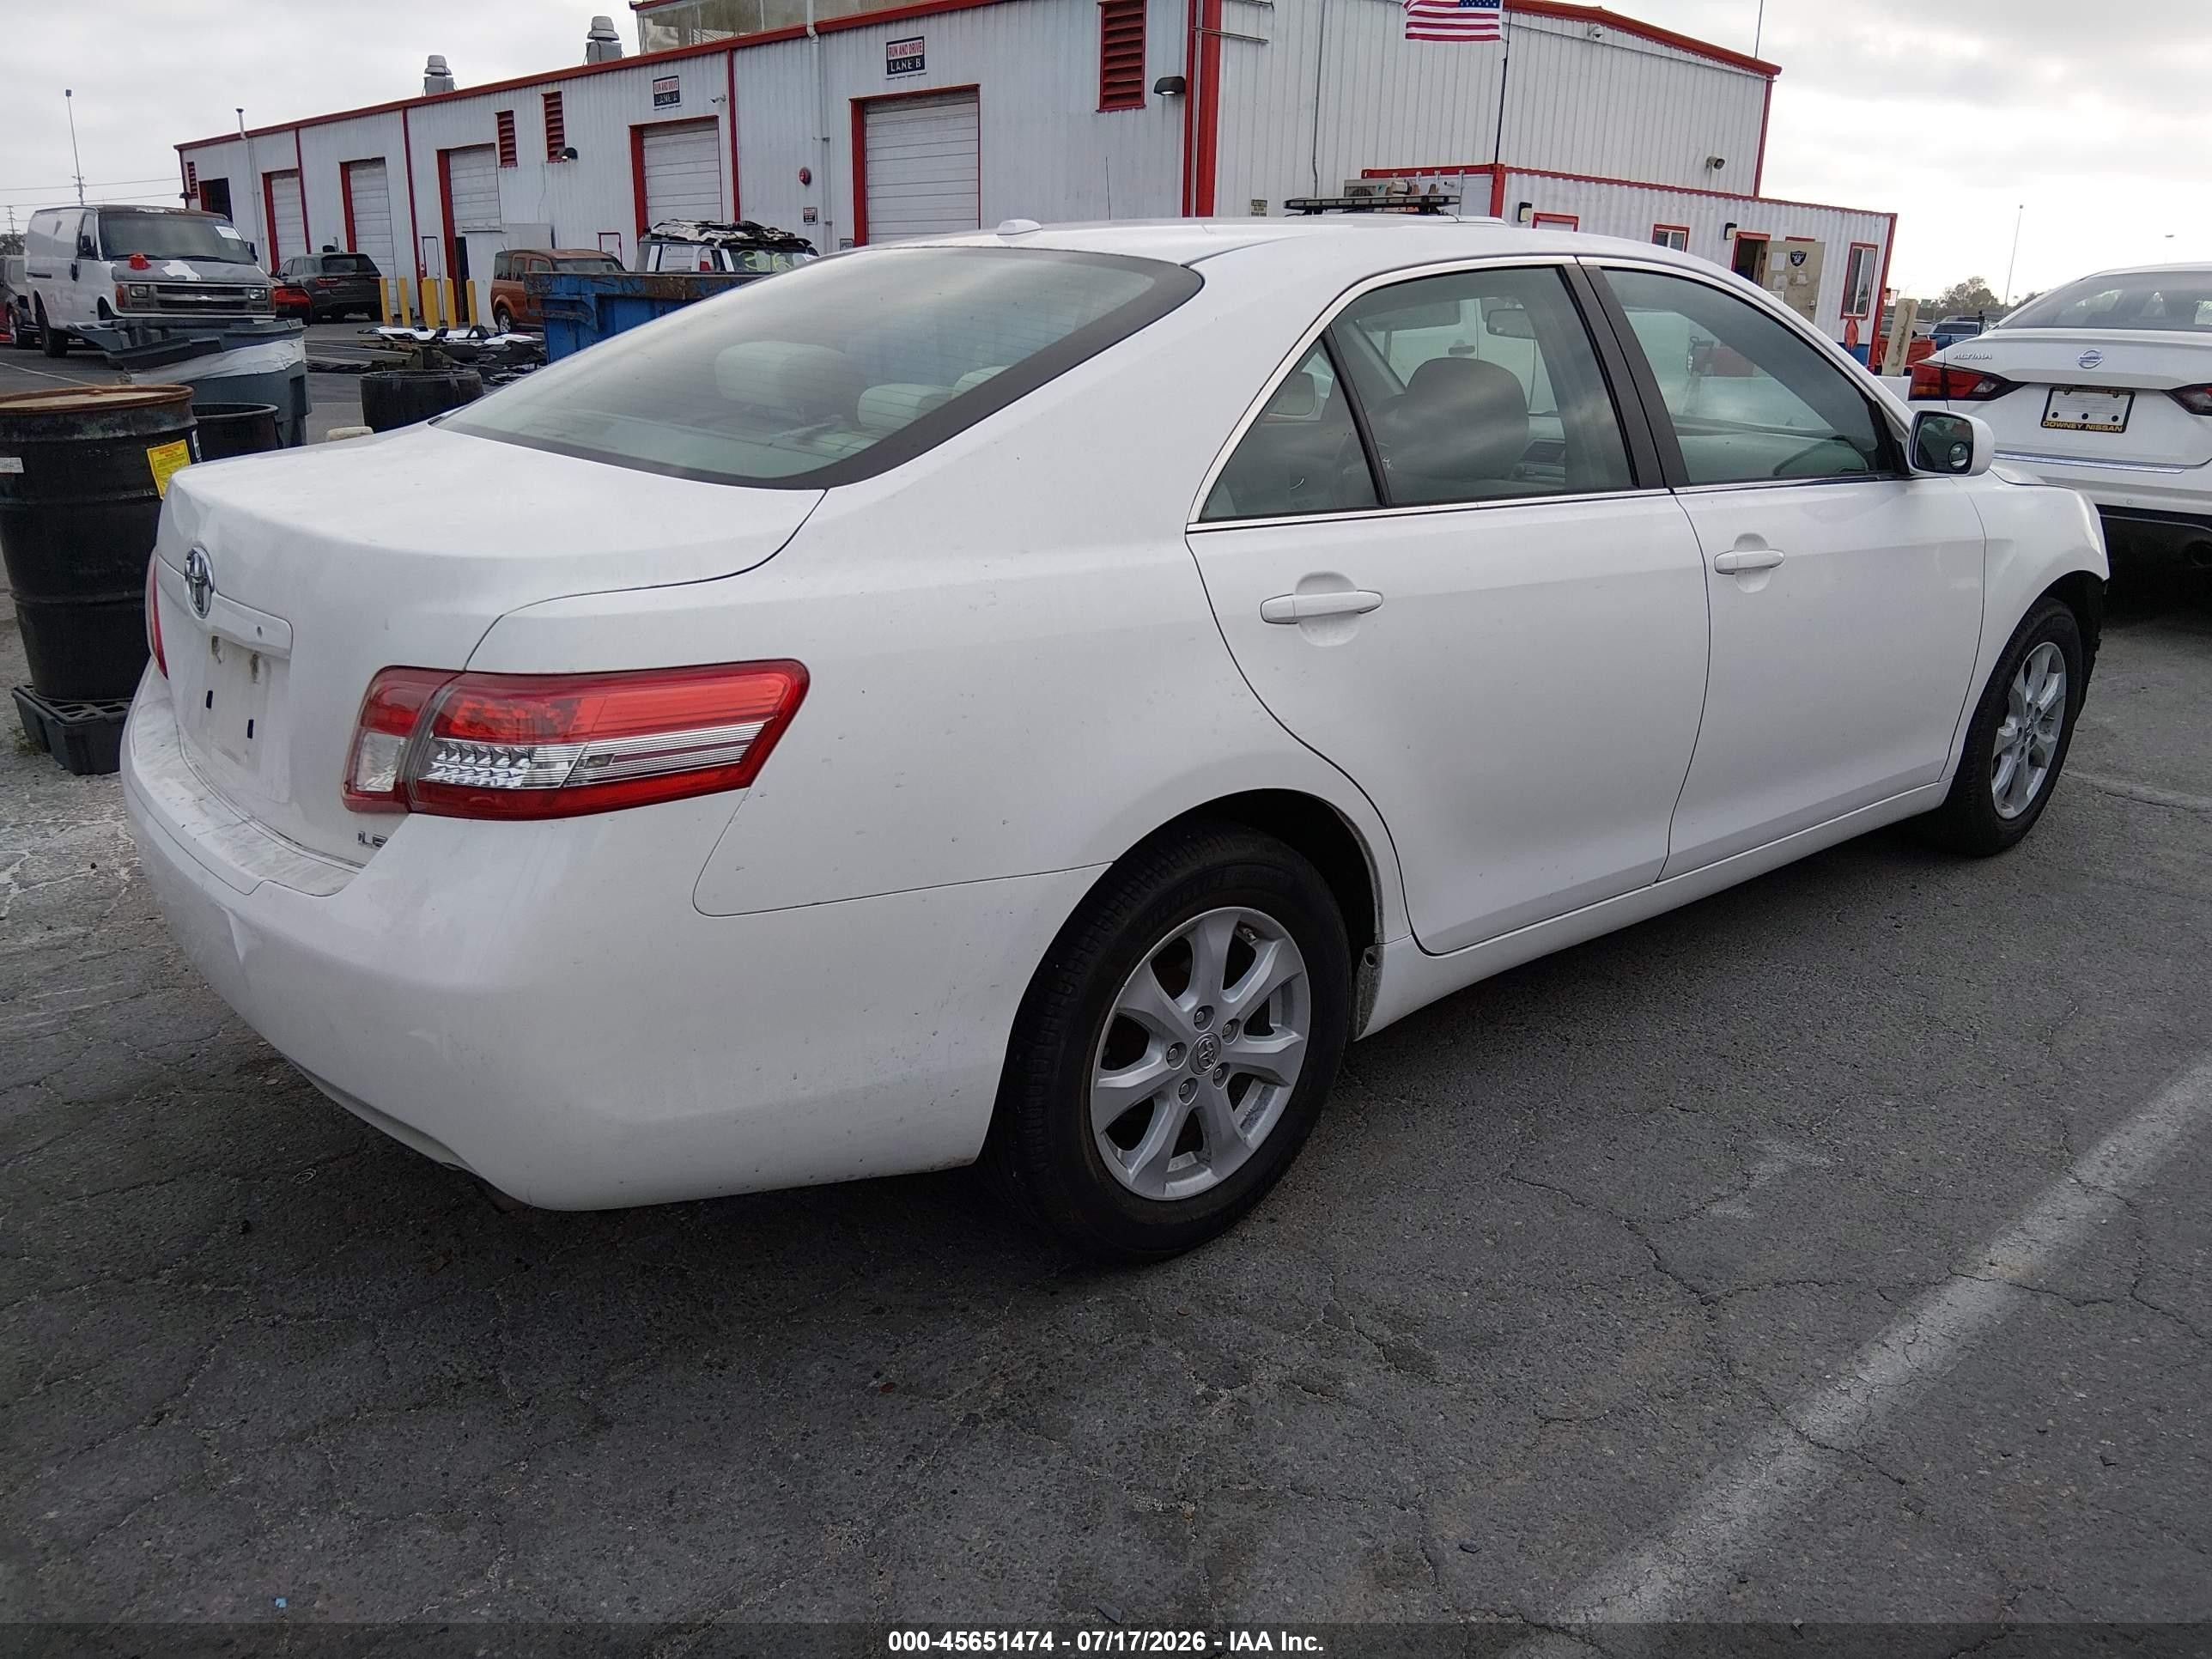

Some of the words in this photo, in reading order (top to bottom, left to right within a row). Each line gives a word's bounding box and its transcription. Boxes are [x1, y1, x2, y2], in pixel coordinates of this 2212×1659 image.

[889, 46, 898, 57] RUN
[899, 44, 908, 56] AND
[908, 41, 922, 54] DRIVE
[890, 59, 913, 71] LANE
[916, 58, 921, 68] B
[1954, 351, 1993, 360] ALTIMA
[2042, 421, 2083, 429] DOWNEY
[2086, 423, 2123, 432] NISSAN
